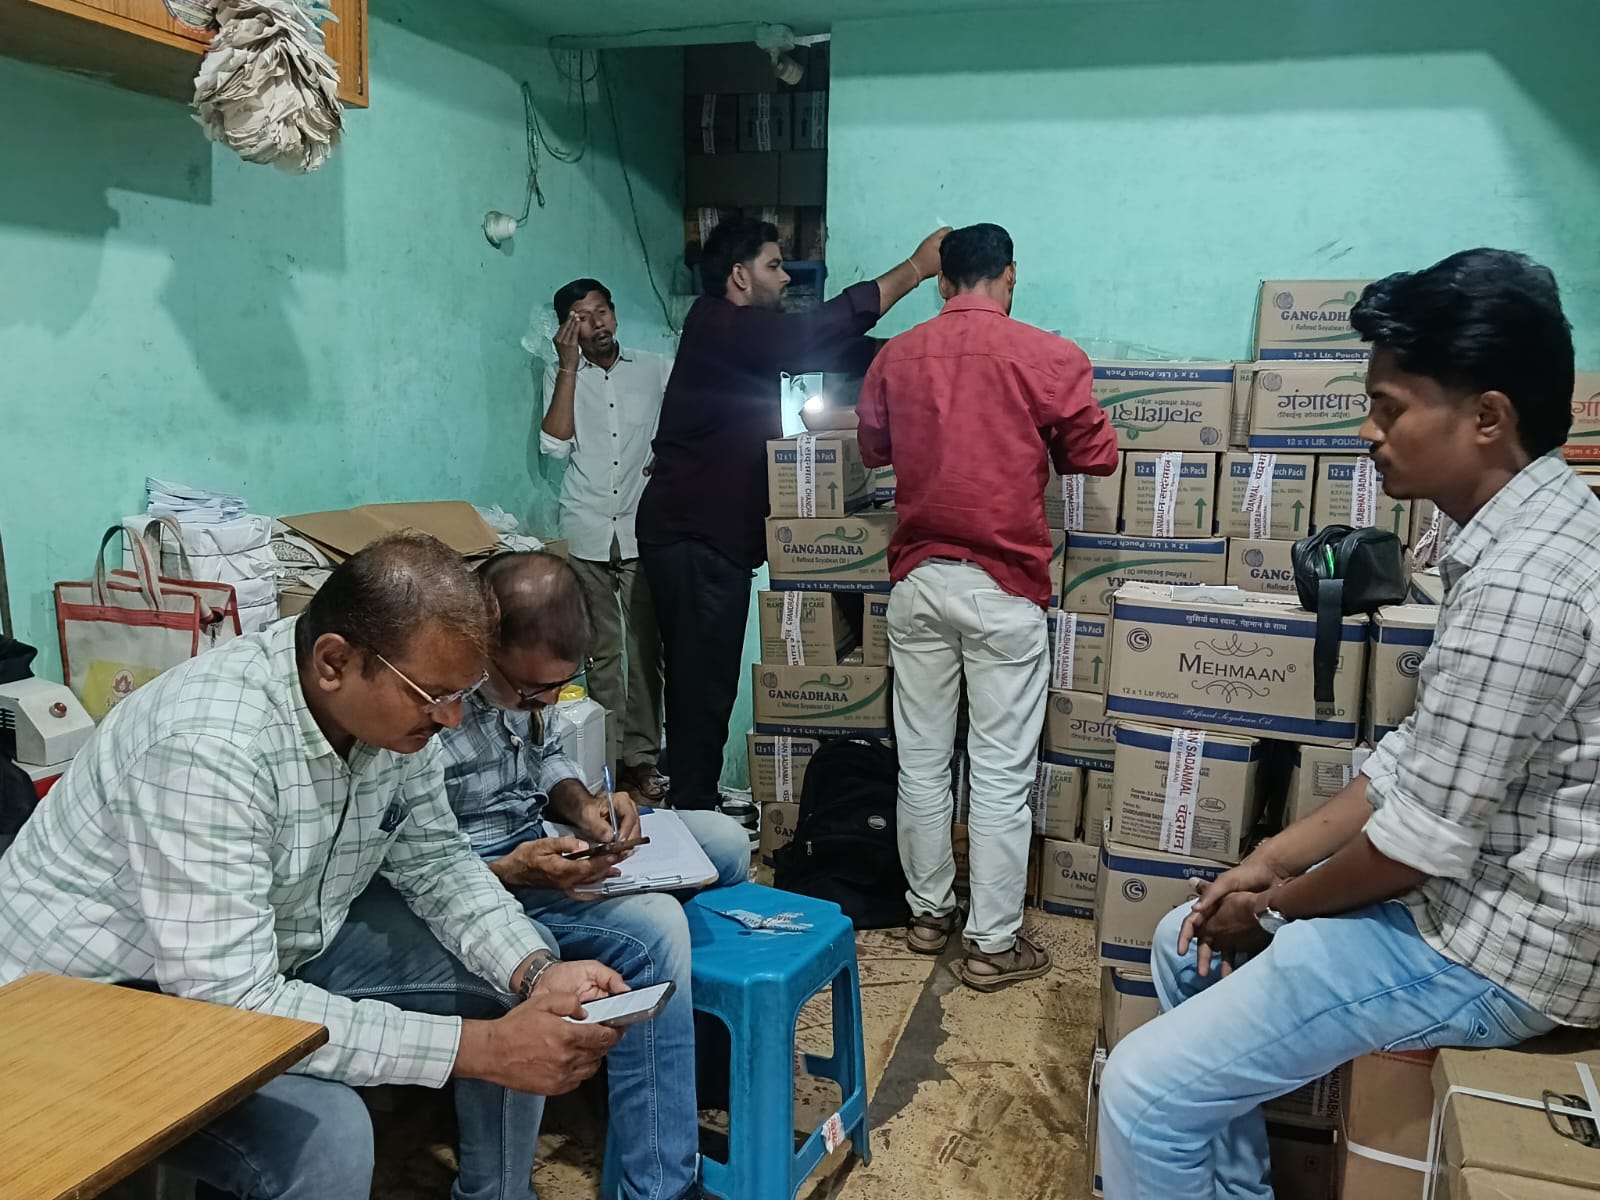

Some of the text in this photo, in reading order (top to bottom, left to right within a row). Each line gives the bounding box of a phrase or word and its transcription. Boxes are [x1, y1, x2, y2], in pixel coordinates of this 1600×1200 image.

[1278, 389, 1368, 412] गंगाधार
[821, 452, 834, 460] Pack
[1190, 466, 1205, 474] Pack
[1232, 465, 1240, 473] 12
[1288, 468, 1304, 476] Pack
[1330, 468, 1338, 476] 12
[804, 488, 812, 518] CHANDRA
[783, 544, 864, 555] GANGADHARA
[1266, 582, 1289, 592] Refined
[1088, 625, 1102, 634] Pack
[1063, 614, 1073, 655] ANDRABHAN
[768, 690, 848, 702] GANGADHARA
[1317, 708, 1344, 716] GOLD
[1180, 745, 1197, 796] SADANMAL
